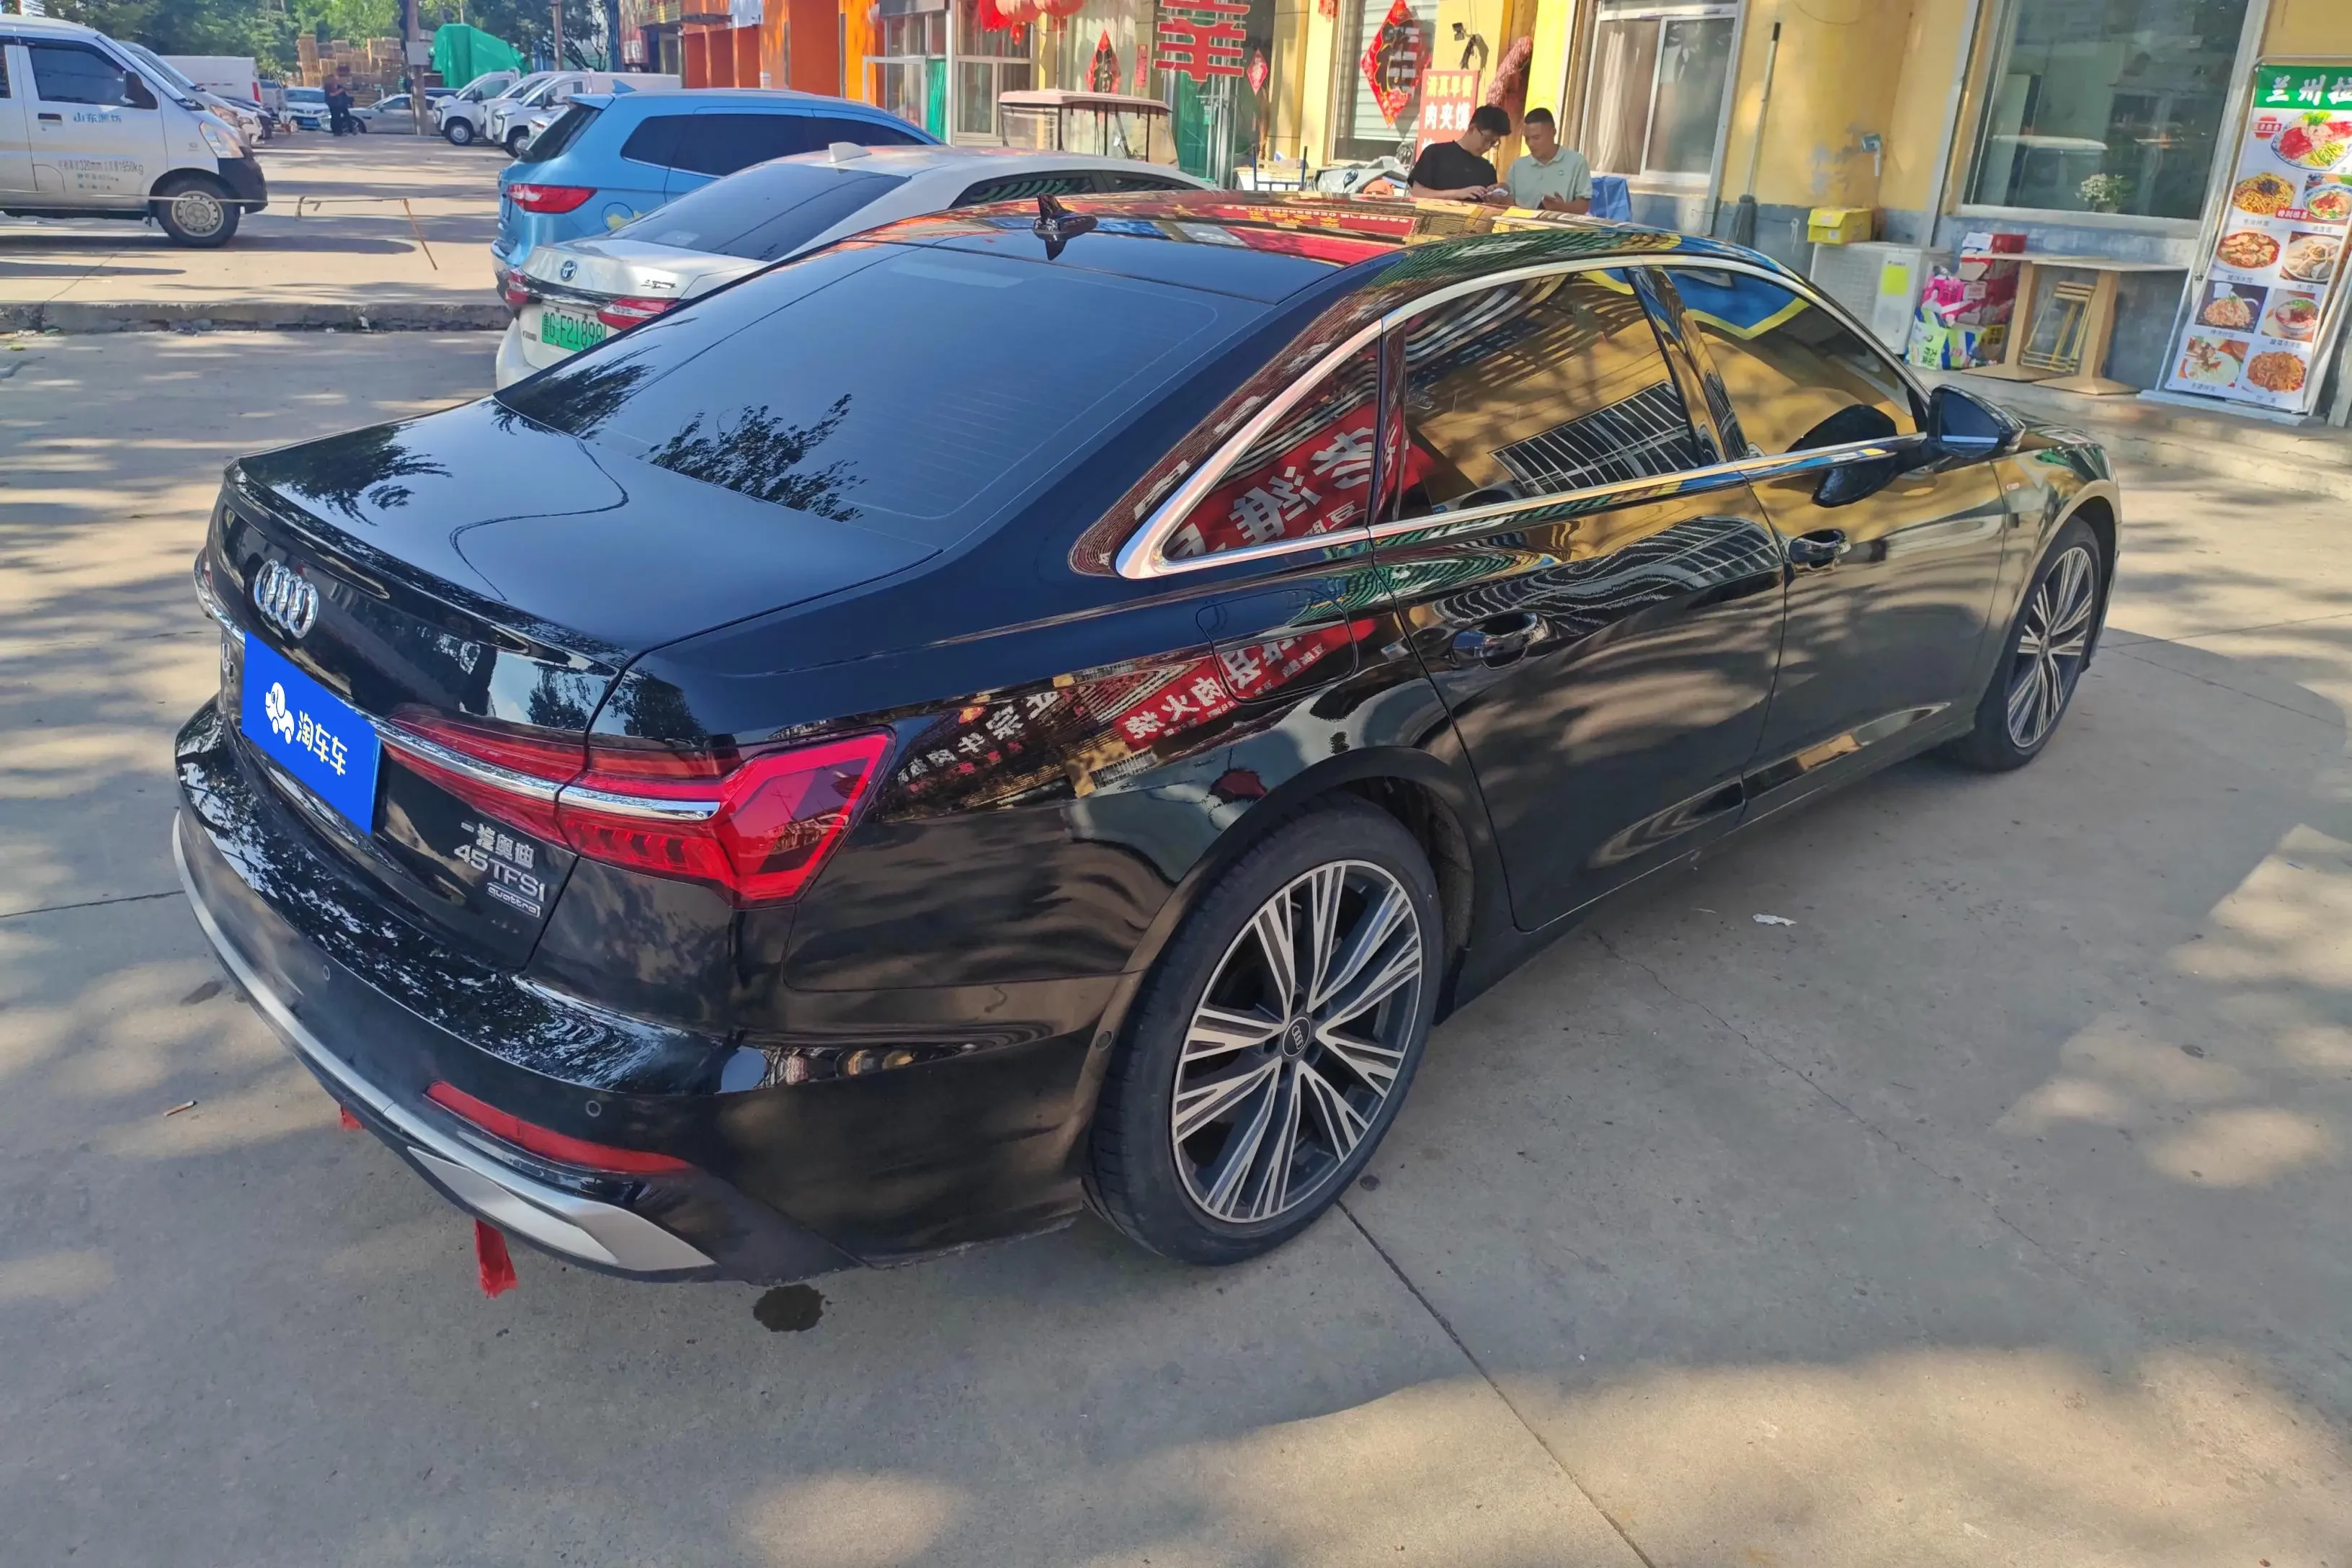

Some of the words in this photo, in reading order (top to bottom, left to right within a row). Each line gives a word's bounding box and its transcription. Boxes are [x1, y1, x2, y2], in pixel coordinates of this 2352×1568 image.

[1427, 74, 1474, 98] 清真早餐
[1424, 102, 1471, 132] 肉夹馍
[58, 160, 103, 172] 320mm
[104, 161, 144, 175] 1950kg
[461, 821, 535, 869] 一汽奥迪
[486, 885, 538, 917] quattro
